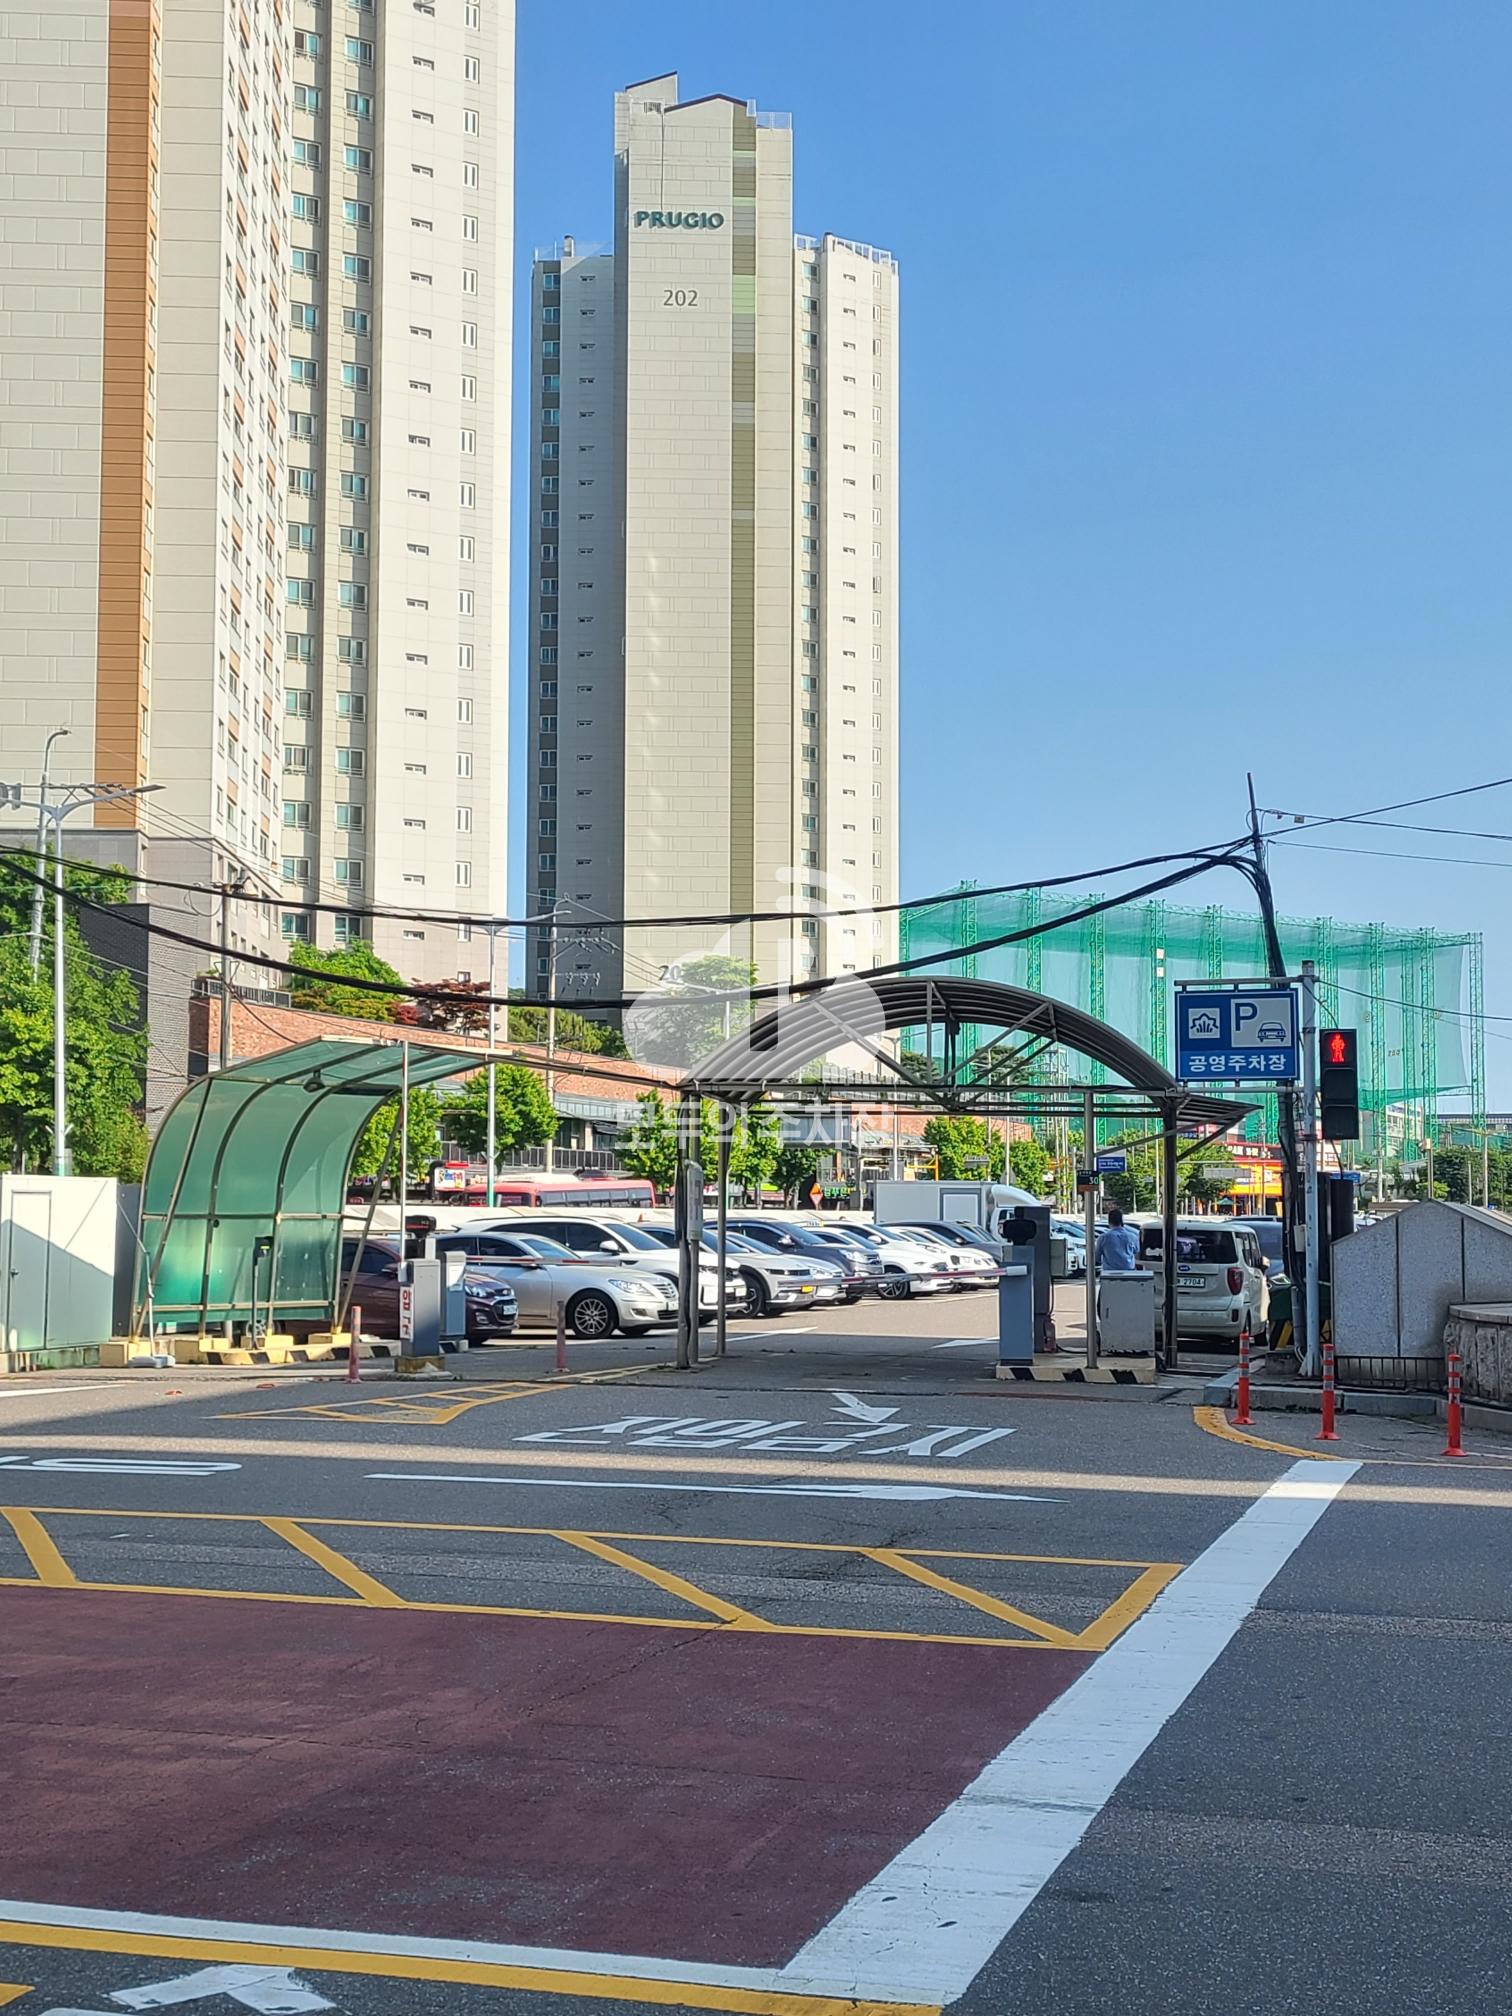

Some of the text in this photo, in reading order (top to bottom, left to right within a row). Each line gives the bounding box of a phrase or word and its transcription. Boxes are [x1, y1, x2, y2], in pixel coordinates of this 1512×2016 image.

[634, 210, 725, 230] PRUGIO
[663, 289, 698, 307] 202
[1235, 1002, 1258, 1032] P
[1188, 1053, 1287, 1073] 공영주차장
[511, 1415, 1018, 1458] 진입금지
